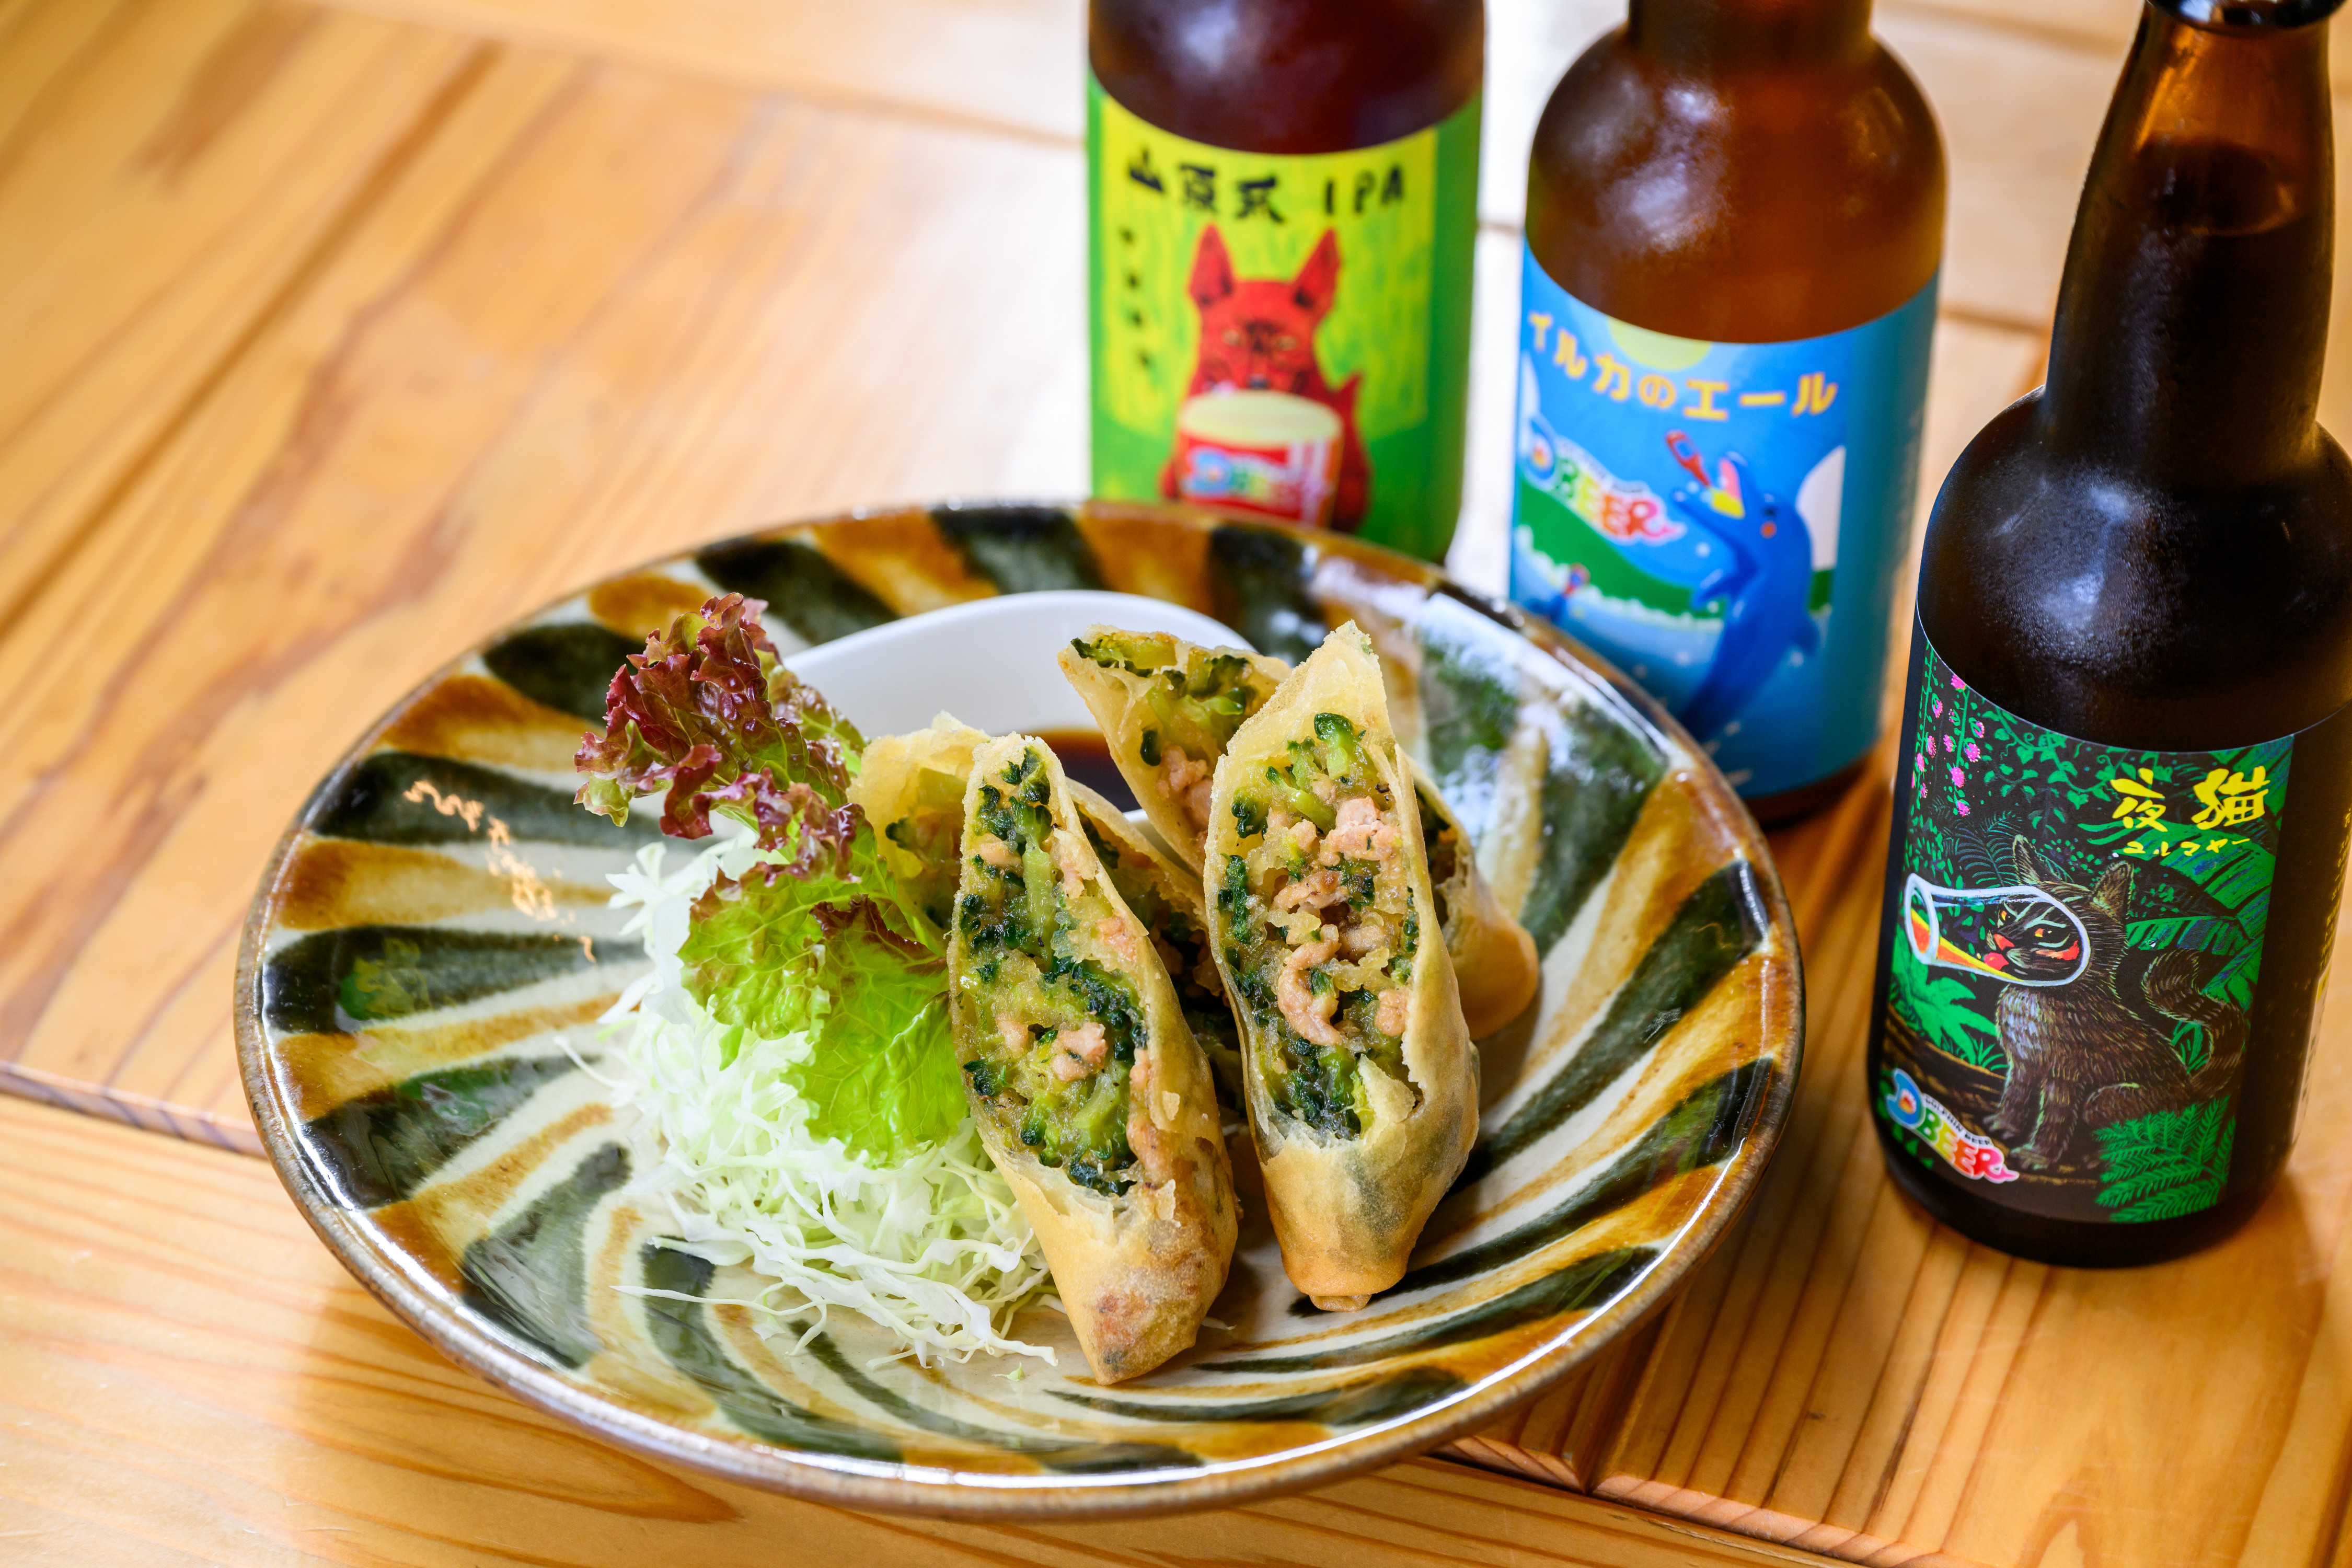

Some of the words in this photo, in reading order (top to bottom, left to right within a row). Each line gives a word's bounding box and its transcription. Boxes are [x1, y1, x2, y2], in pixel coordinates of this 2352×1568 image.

[1325, 164, 1404, 215] IPA
[1529, 311, 1838, 421] イルカのエール
[2110, 765, 2272, 833] 夜猫
